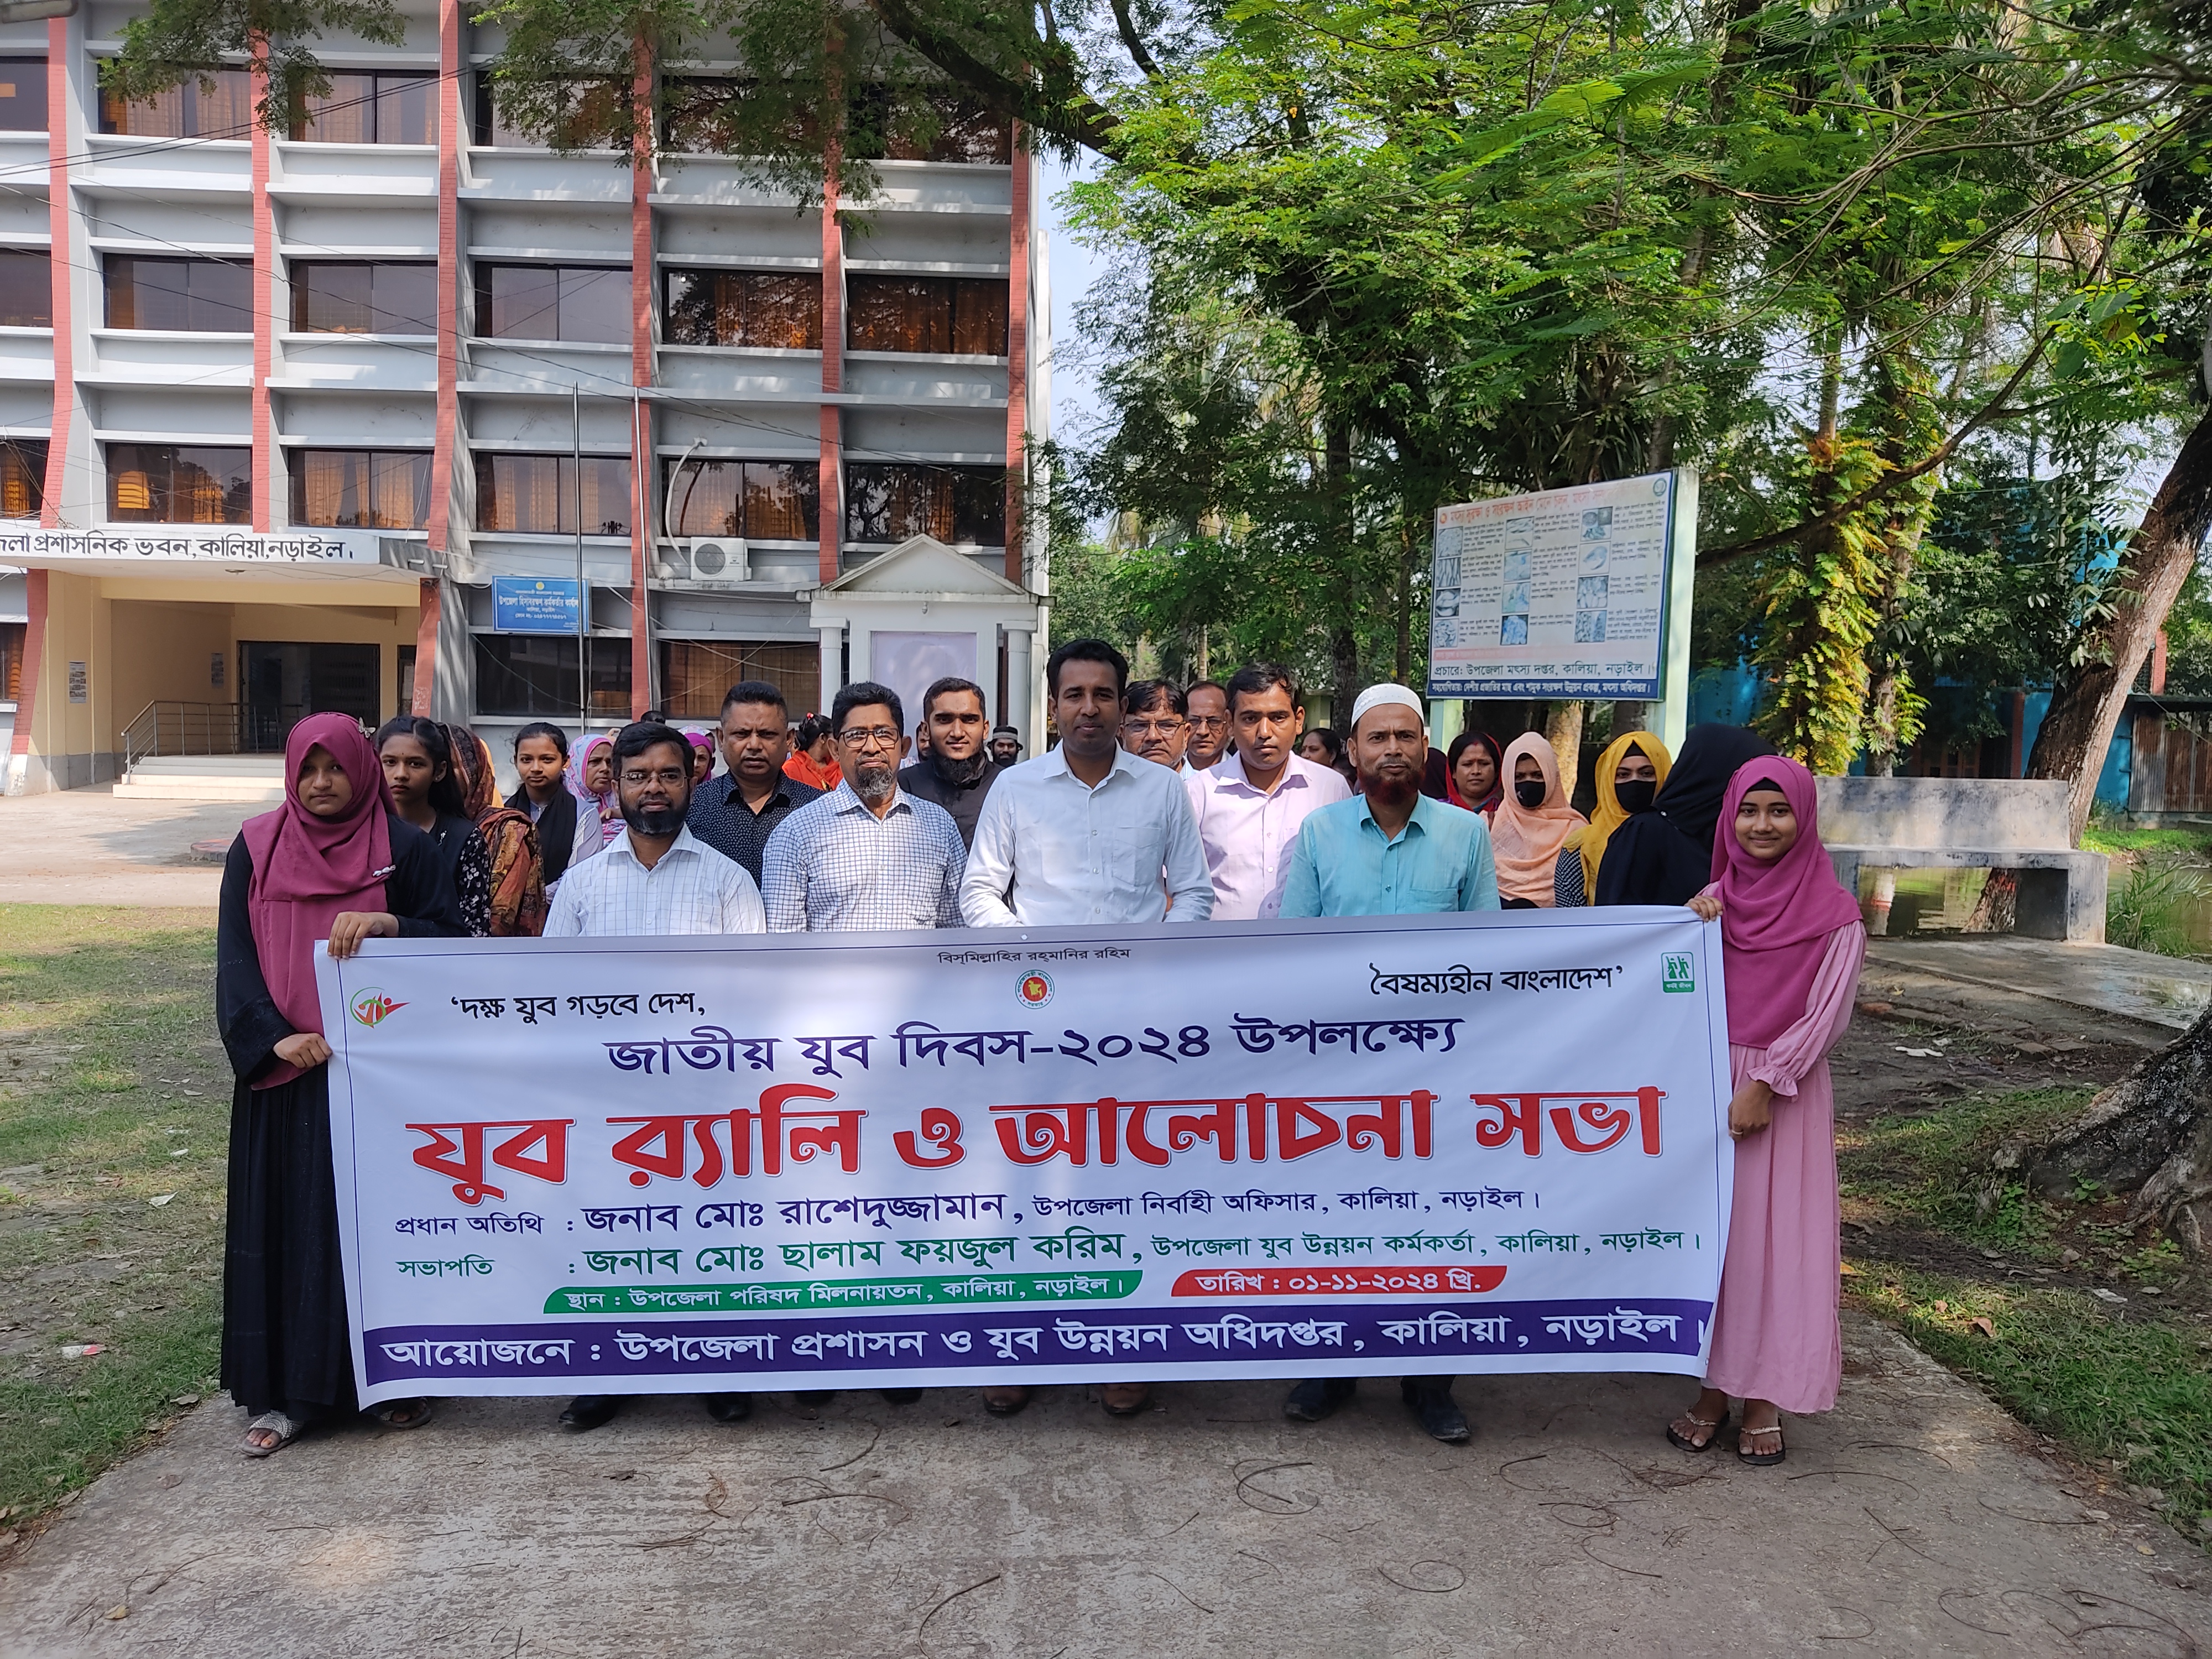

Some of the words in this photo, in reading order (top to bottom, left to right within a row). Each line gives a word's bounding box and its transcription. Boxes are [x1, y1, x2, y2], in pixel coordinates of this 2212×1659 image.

[34, 530, 130, 555] প্রশাসনিক
[1466, 663, 1503, 675] উপজেলা
[1507, 665, 1531, 675] মৎস্য
[1093, 947, 1131, 959] রহিম
[1369, 962, 1491, 996] বৈষম্যহীন
[514, 996, 557, 1025] যুব
[567, 994, 639, 1020] গড়বে
[648, 992, 706, 1016] দেশ,
[601, 1025, 784, 1075] জাতীয়
[792, 1034, 879, 1079] যুব
[1228, 1012, 1466, 1057] উপলক্ষ্যে
[404, 1115, 577, 1206] যুব
[891, 1106, 967, 1170] ও
[988, 1088, 1440, 1168] আলোচনা
[1469, 1085, 1668, 1159] সভা
[395, 1214, 458, 1237] প্রধান
[465, 1210, 545, 1235] অতিথি
[580, 1203, 684, 1234] জনাব
[694, 1199, 765, 1230] মোঃ
[1031, 1194, 1134, 1217] উপজেলা
[1138, 1189, 1217, 1216] নির্বাহী
[395, 1254, 496, 1279] সভাপতি
[580, 1246, 684, 1277] জনাব
[695, 1243, 765, 1275] মোঃ
[776, 1239, 888, 1273] ছালাম
[895, 1236, 1020, 1270] ফয়জুল
[1149, 1233, 1253, 1258] উপজেলা
[1259, 1237, 1293, 1260] যুব
[1301, 1232, 1375, 1258] উন্নয়ন
[563, 1291, 608, 1311] স্থান
[628, 1287, 722, 1307] উপজেলা
[729, 1284, 800, 1306] পরিষদ
[1194, 1270, 1266, 1293] তারিখ
[1287, 1272, 1440, 1293] ০১-১১-২০২৪
[379, 1336, 576, 1368] আয়োজনে
[612, 1329, 781, 1364] উপজেলা
[791, 1328, 929, 1361] প্রশাসন
[940, 1331, 973, 1354] ও
[982, 1326, 1045, 1361] যুব
[1051, 1317, 1172, 1357] উন্নয়ন
